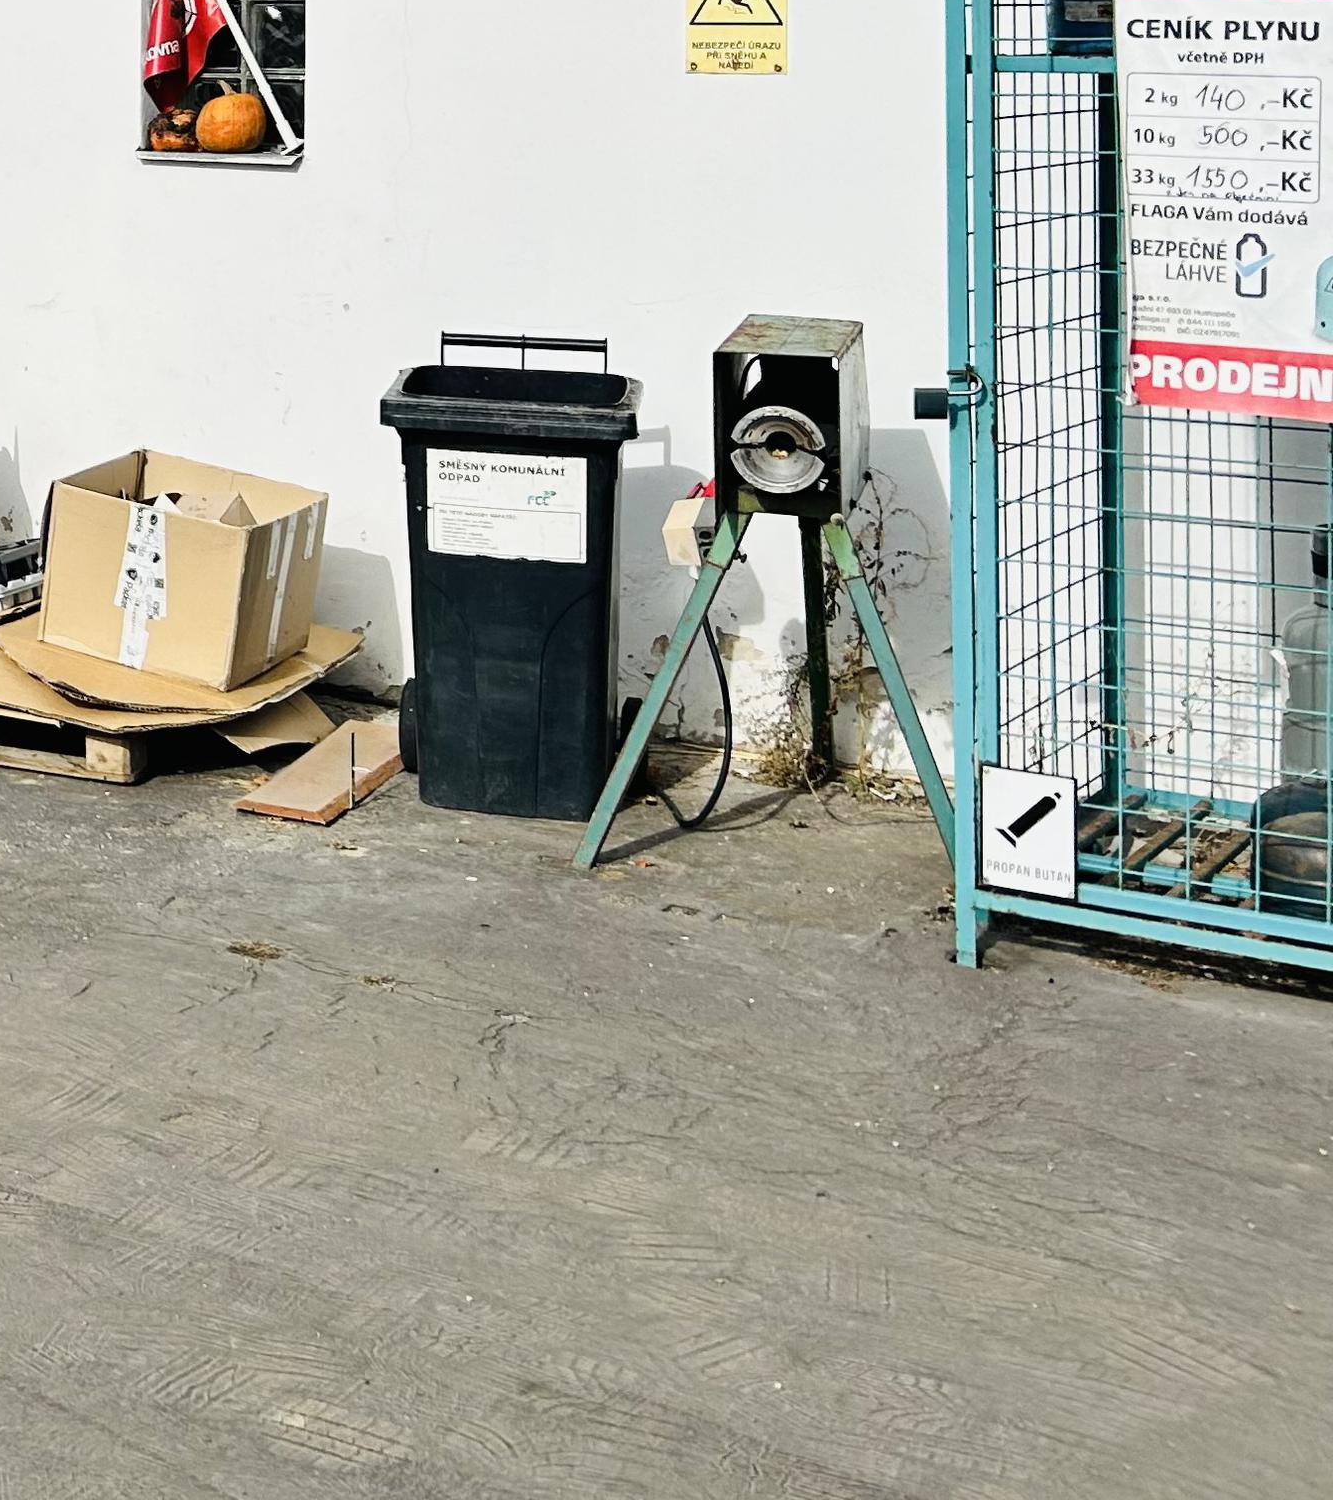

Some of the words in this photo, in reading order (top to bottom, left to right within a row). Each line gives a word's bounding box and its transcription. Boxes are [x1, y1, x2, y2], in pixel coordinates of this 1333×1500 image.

[1127, 16, 1213, 40] CENÍK
[1224, 20, 1320, 41] PLYNU
[1177, 51, 1228, 64] včetně
[1233, 52, 1264, 64] DPH
[1145, 88, 1155, 103] 2
[1161, 92, 1178, 106] kg
[1195, 84, 1246, 111] 140
[1134, 128, 1155, 143] 10
[1159, 132, 1176, 147] kg
[1131, 169, 1154, 184] 33
[1158, 173, 1175, 188] kg
[1186, 165, 1248, 190] 1550
[1131, 204, 1189, 219] FLAGA
[1193, 206, 1233, 222] Vám
[1238, 209, 1308, 226] dodává
[1131, 237, 1228, 261] BEZPEČNÉ
[1165, 259, 1228, 283] LÁHVE
[439, 460, 486, 472] SMĚSNÝ
[491, 464, 565, 477] KOMUNÁLNÍ
[439, 472, 480, 483] ODPAD
[986, 859, 1030, 877] PROPAN
[1035, 867, 1071, 883] BUTAN
